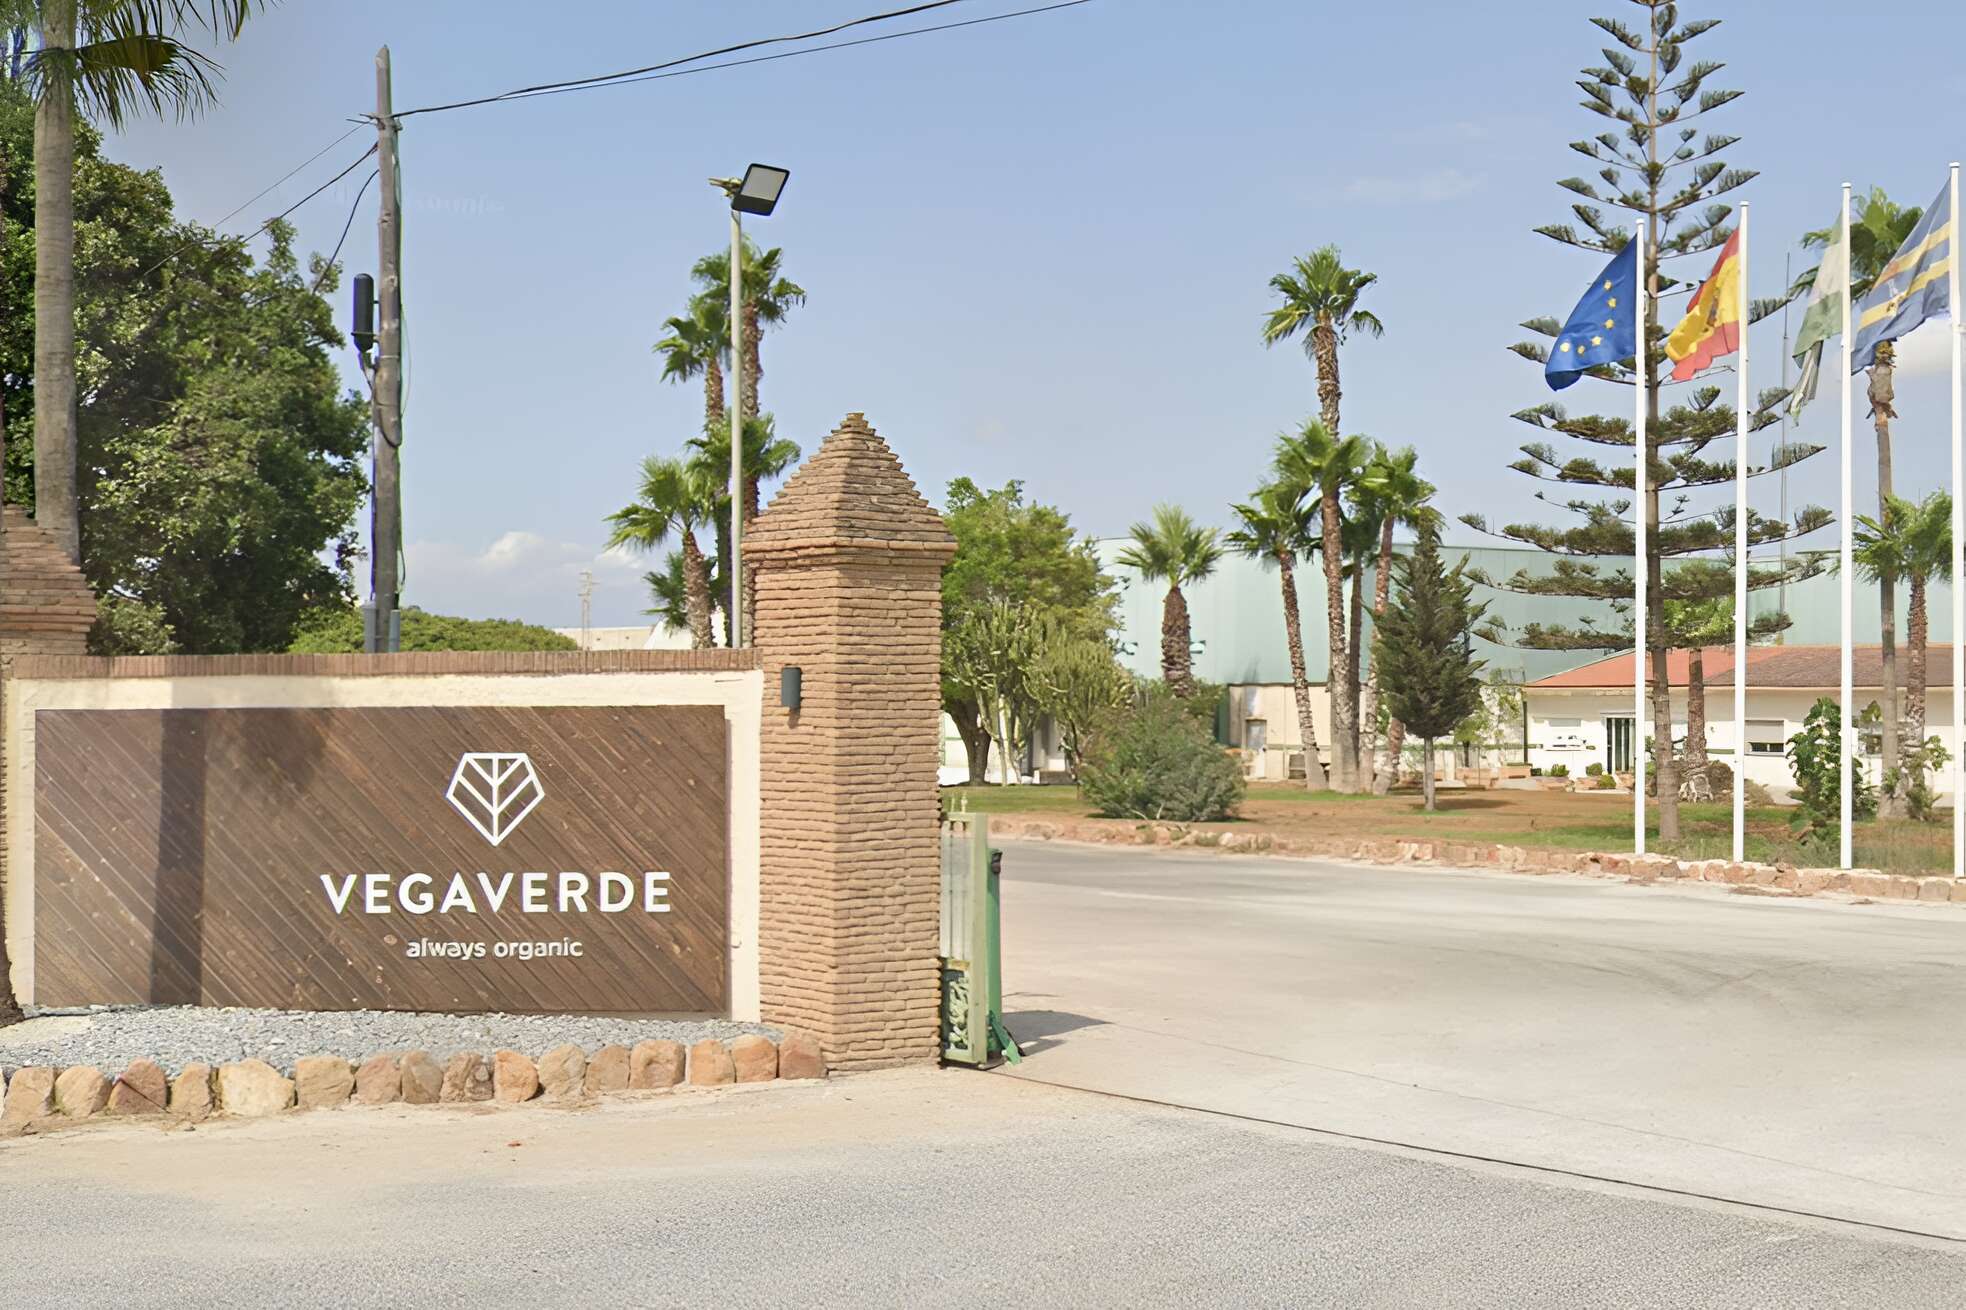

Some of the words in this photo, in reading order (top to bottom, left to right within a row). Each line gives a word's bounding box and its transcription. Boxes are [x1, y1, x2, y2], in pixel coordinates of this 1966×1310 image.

[319, 871, 672, 915] VEGAVERDE
[405, 936, 488, 961] always
[493, 936, 584, 961] organic
